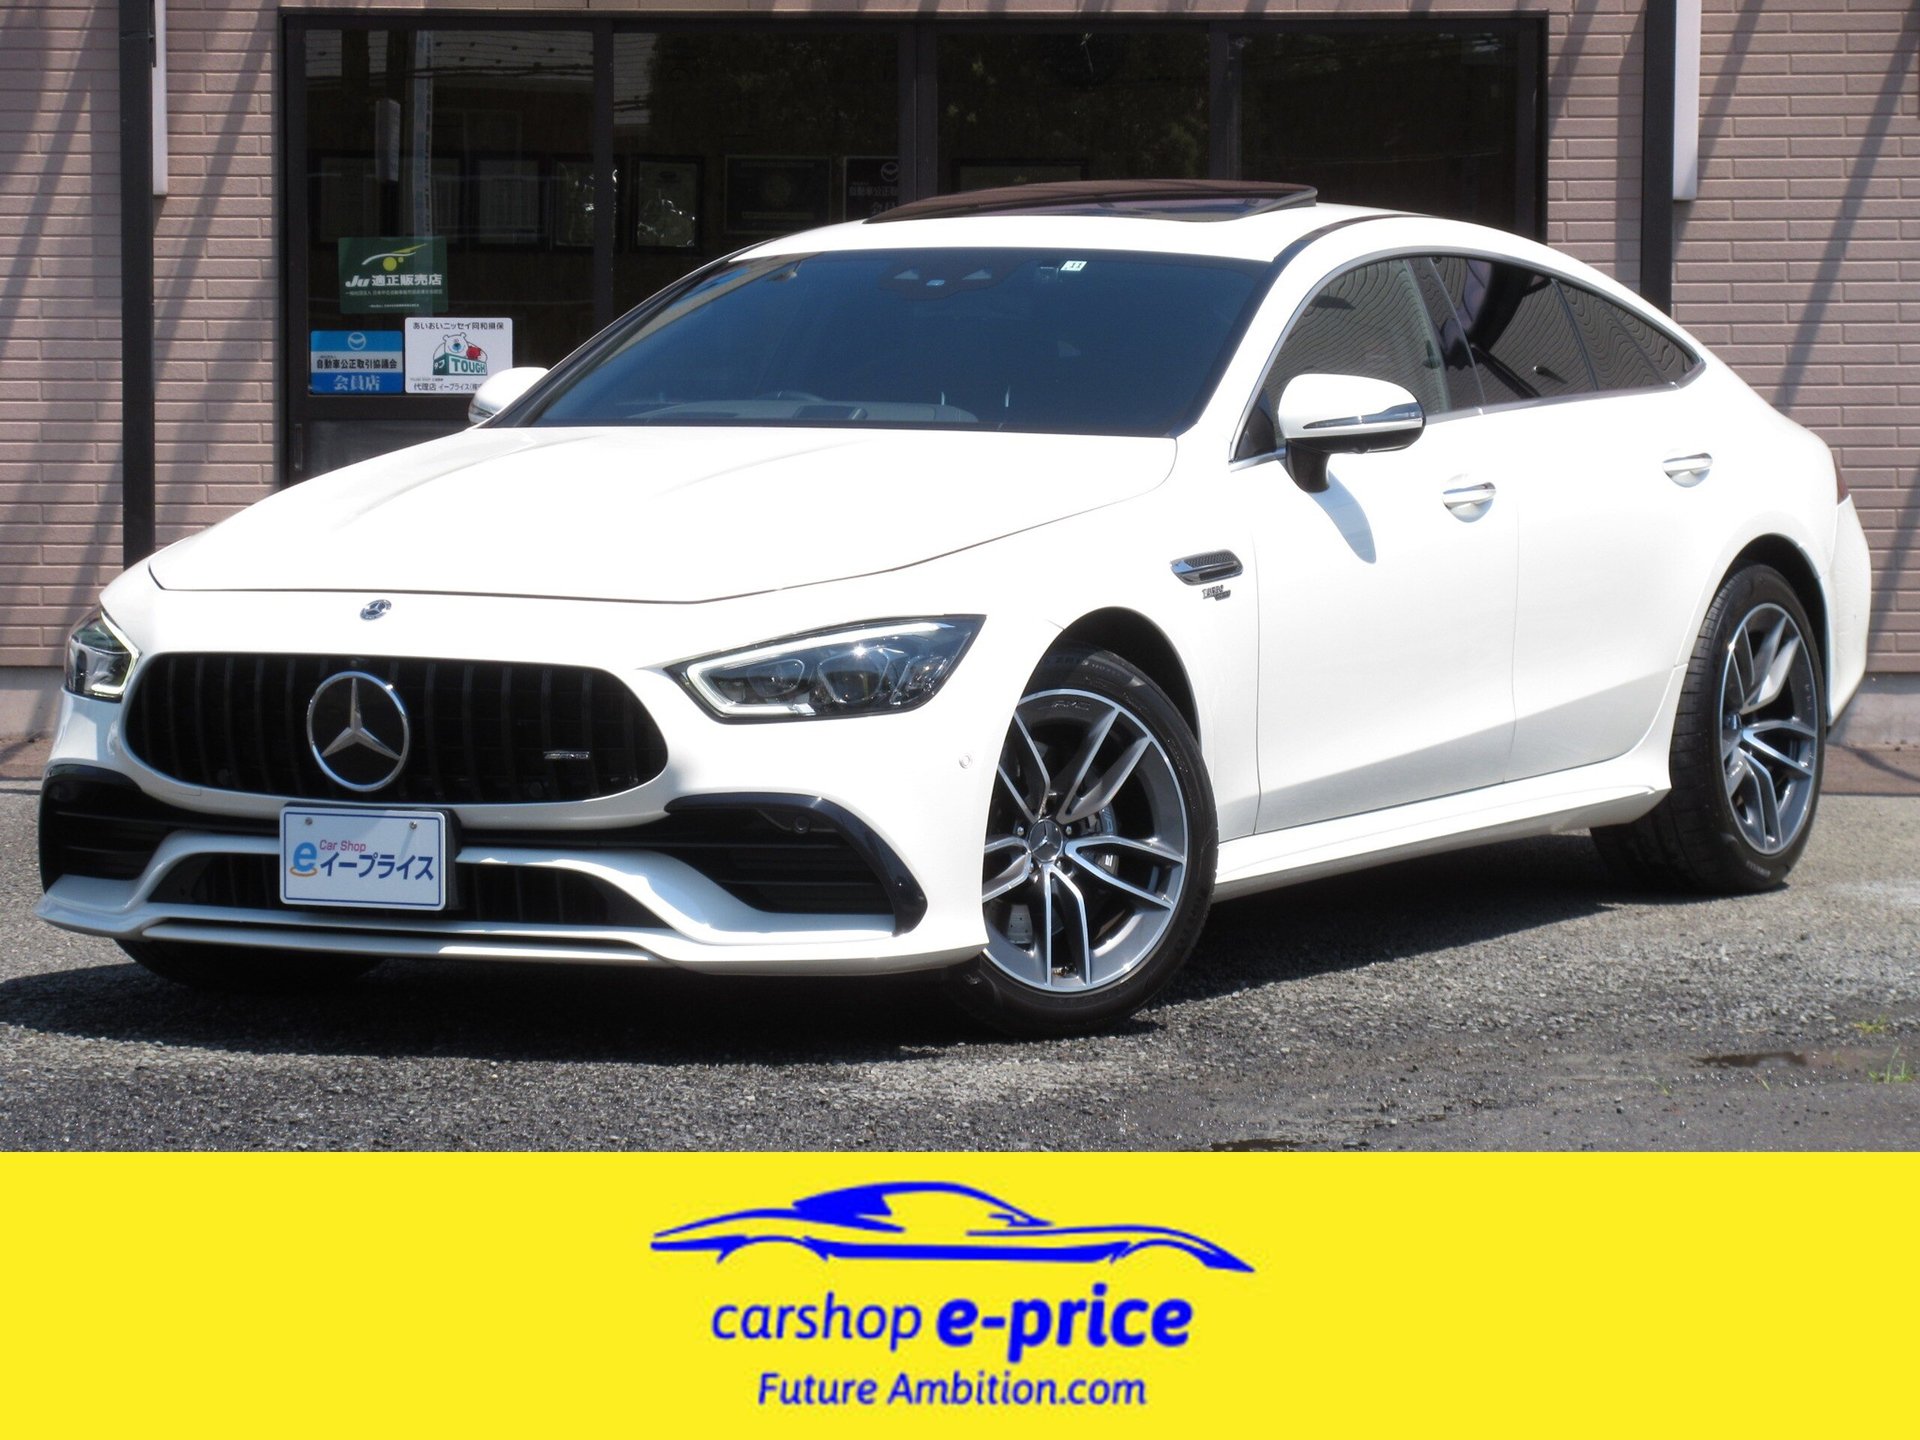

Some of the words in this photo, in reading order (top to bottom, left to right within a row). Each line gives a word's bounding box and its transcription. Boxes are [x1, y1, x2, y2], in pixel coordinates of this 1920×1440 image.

[371, 274, 442, 286] 適正販売店
[412, 321, 504, 331] あいおいニッセイ同和損保
[316, 358, 398, 369] 自動車公正取引協議会
[450, 358, 486, 373] TOUGH
[333, 374, 381, 391] 会員店
[413, 382, 437, 391] 代理店
[319, 839, 338, 850] Car
[339, 840, 367, 853] Shop
[320, 852, 434, 881] イープライス
